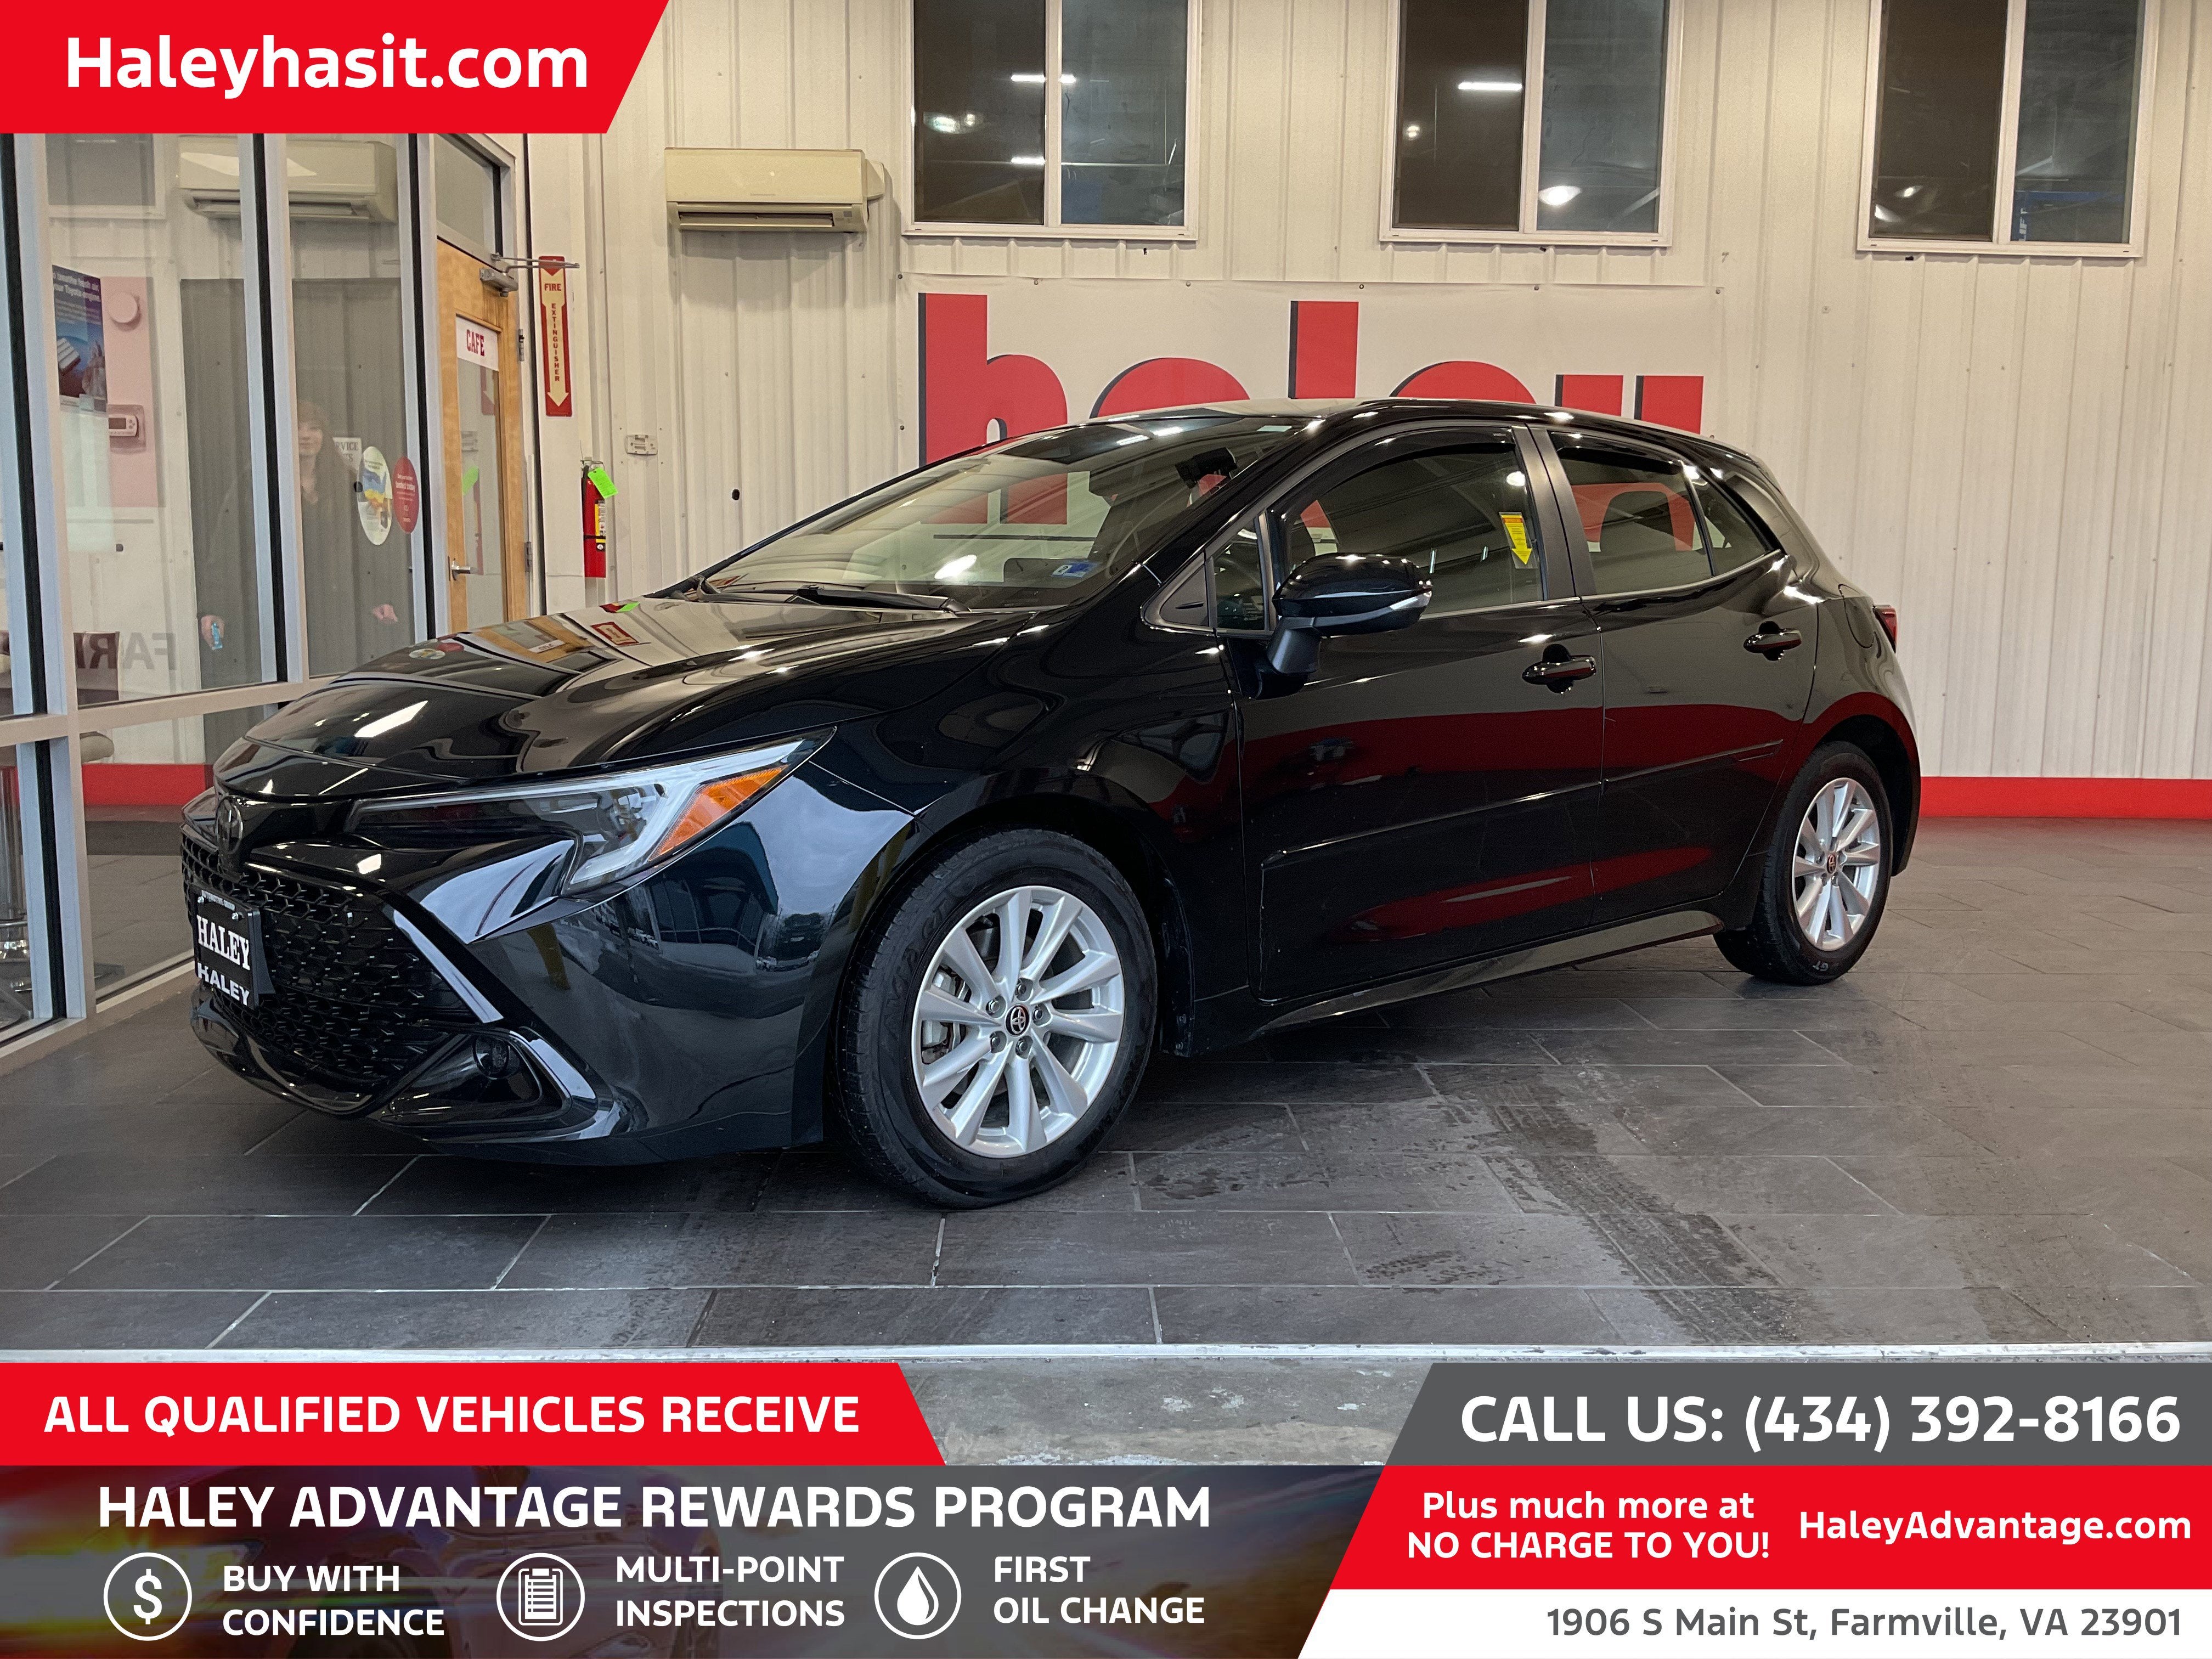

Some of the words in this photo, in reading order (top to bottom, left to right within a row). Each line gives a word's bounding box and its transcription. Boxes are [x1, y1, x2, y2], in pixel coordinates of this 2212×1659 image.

[544, 283, 562, 291] FIRE
[466, 329, 485, 357] CAFE
[551, 303, 560, 382] EXTINGUISHER
[196, 914, 250, 970] HALEY
[197, 962, 250, 1006] HALEY
